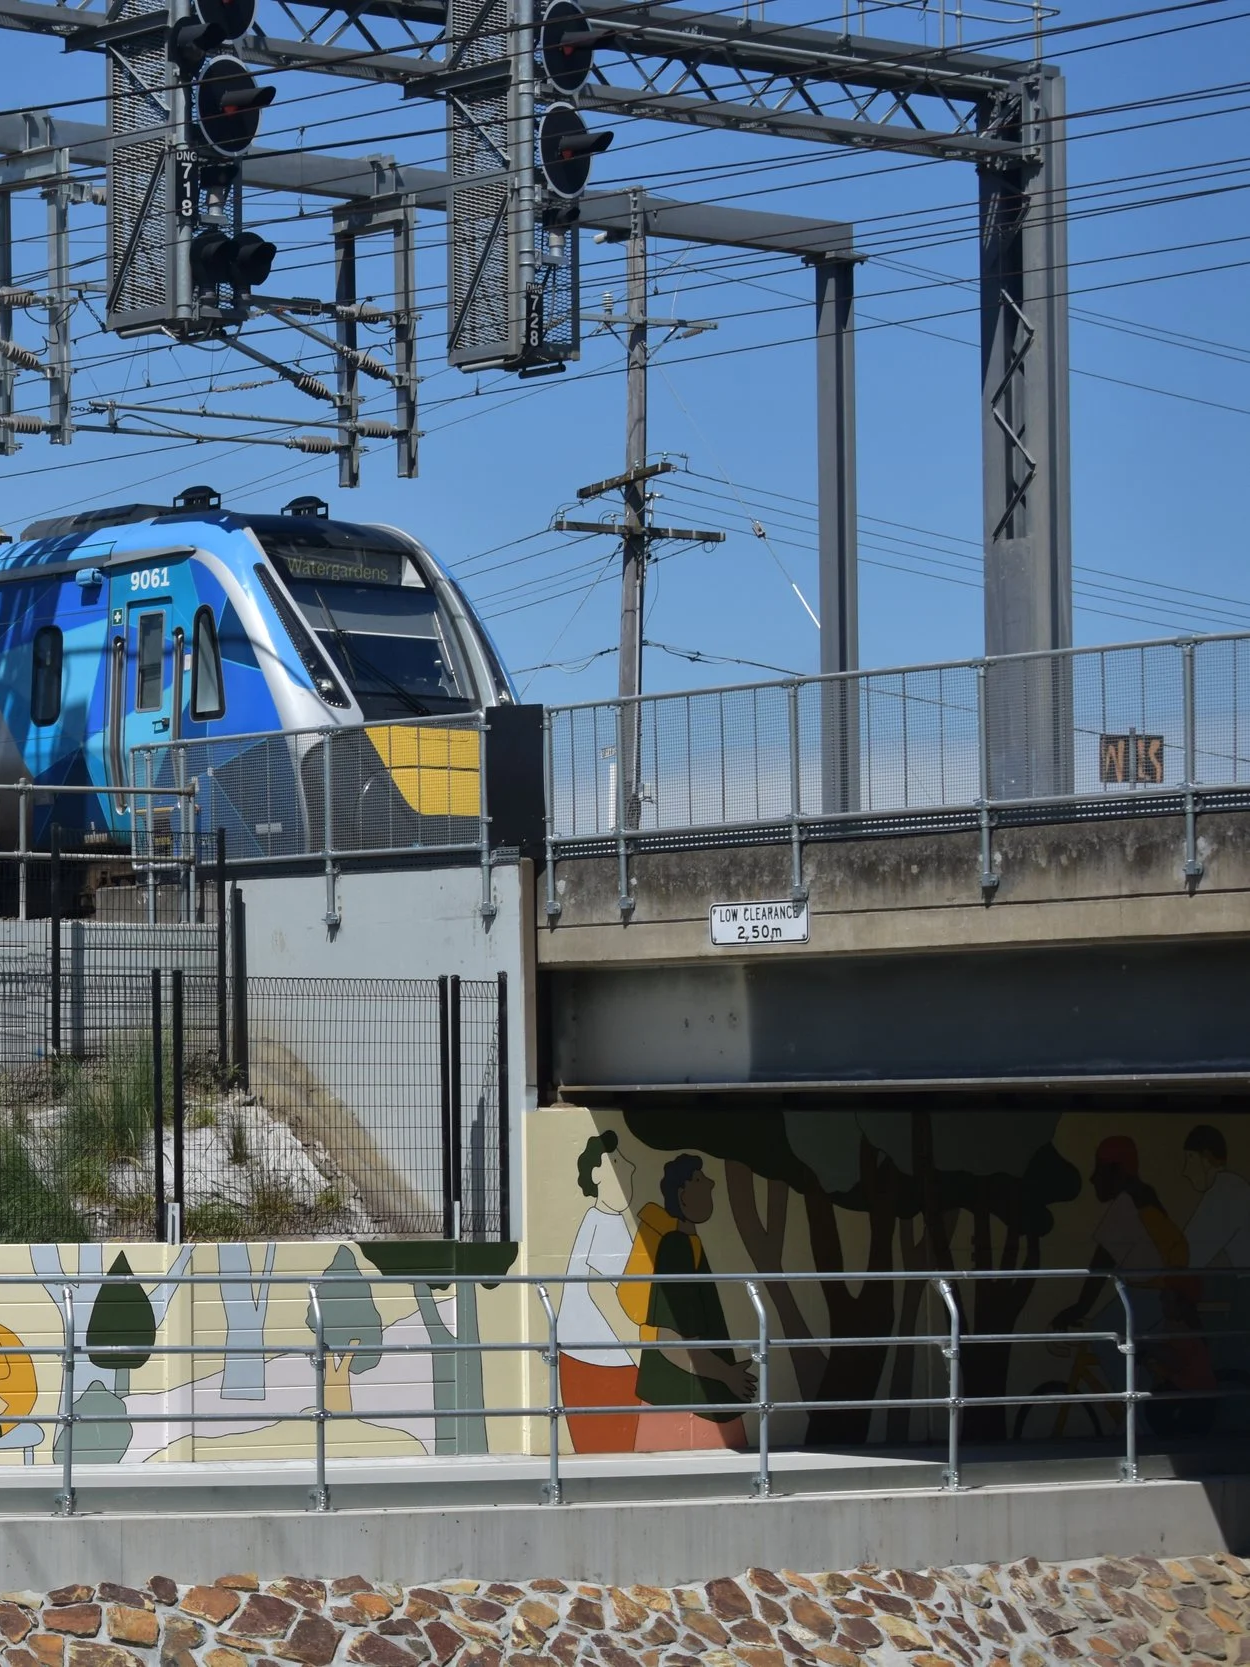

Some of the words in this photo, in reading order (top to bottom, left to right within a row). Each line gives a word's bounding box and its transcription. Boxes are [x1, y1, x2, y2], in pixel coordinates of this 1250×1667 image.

[176, 151, 198, 162] DNG
[181, 162, 193, 217] 718
[530, 295, 540, 347] 728
[130, 567, 170, 591] 9061
[287, 556, 389, 582] Watergardens
[720, 908, 738, 922] LOW
[743, 904, 800, 921] CLEARANCE
